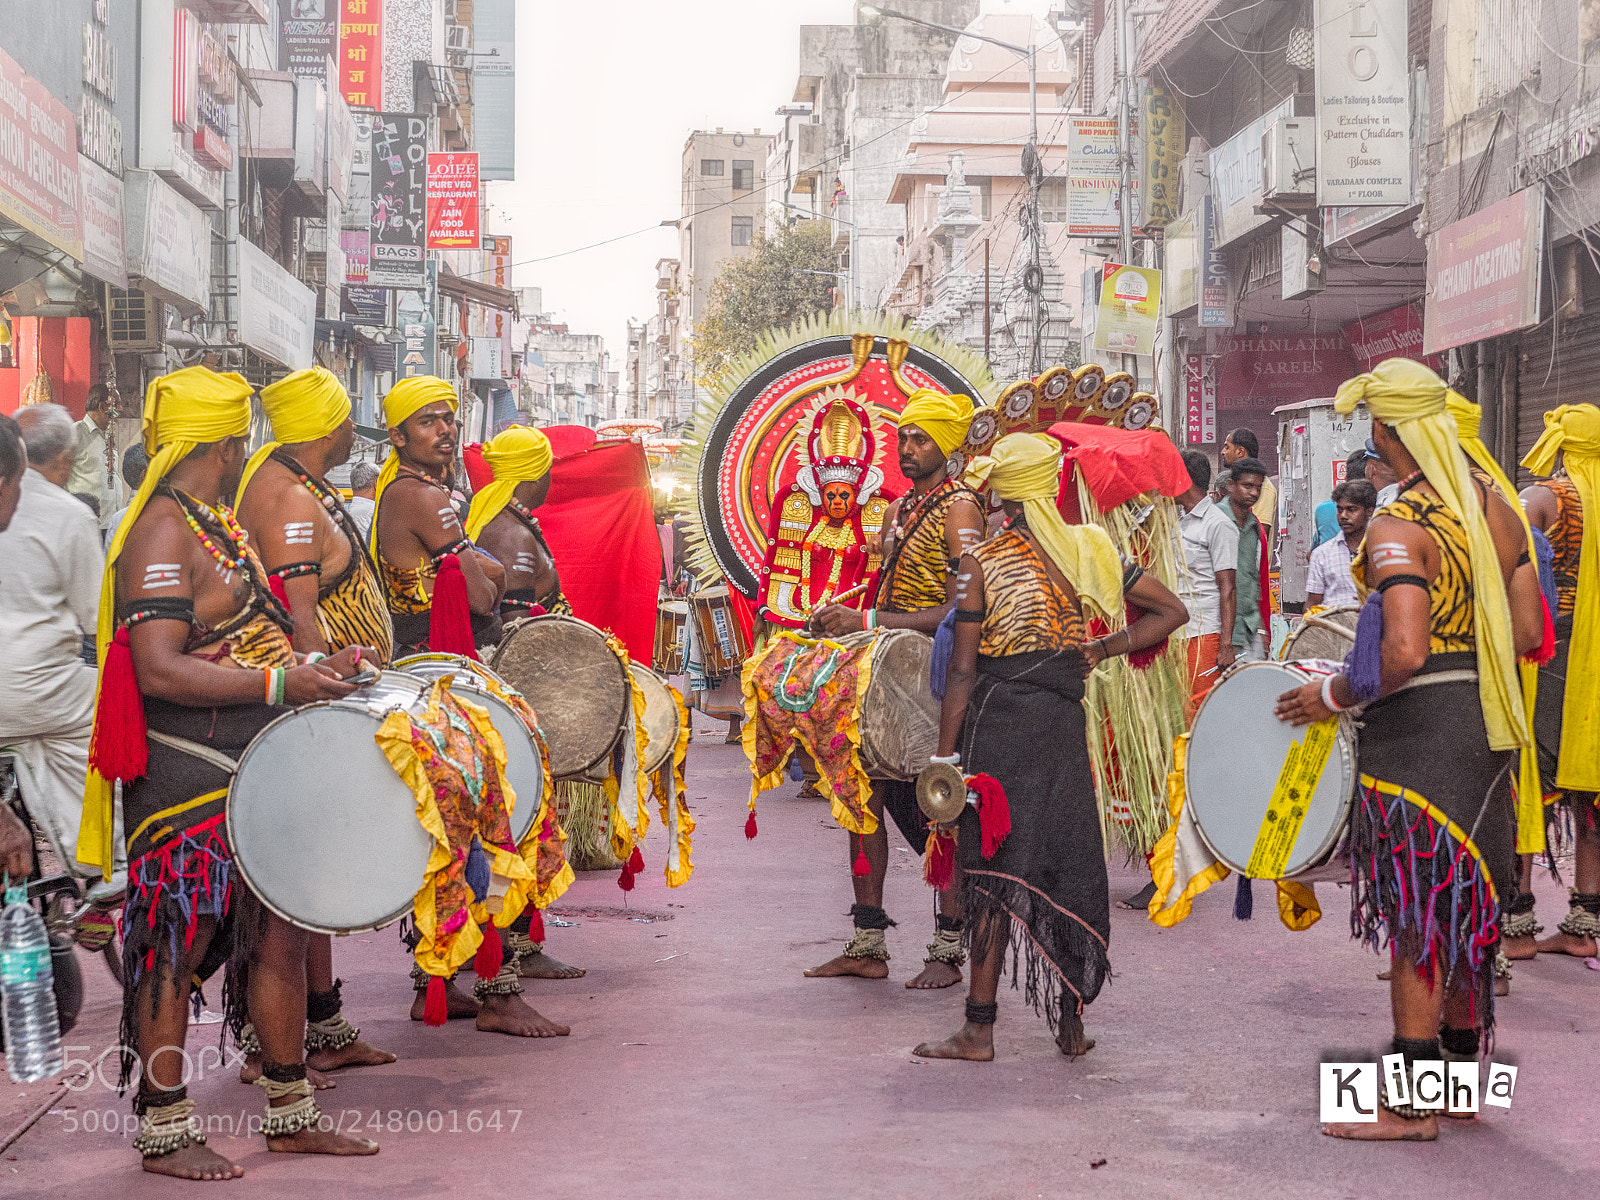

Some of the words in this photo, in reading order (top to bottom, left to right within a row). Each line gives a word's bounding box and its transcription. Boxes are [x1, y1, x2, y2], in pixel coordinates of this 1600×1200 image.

[283, 20, 335, 35] NISHA
[290, 55, 326, 63] BRIDAL
[1323, 96, 1343, 105] Ladies
[1344, 96, 1369, 106] Tailoring
[1370, 96, 1376, 104] &
[1377, 95, 1404, 107] Boutique
[1337, 115, 1380, 126] Exclusive
[1382, 115, 1390, 124] in
[1324, 129, 1358, 143] Pattern
[1360, 128, 1404, 141] Chudidars
[1360, 142, 1368, 153] &
[1347, 156, 1382, 168] Blouses
[27, 137, 78, 211] JEWELLERY
[405, 118, 426, 243] DOLLY
[1070, 180, 1105, 189] VARSHA
[1326, 178, 1365, 186] VARADAAN
[1366, 178, 1402, 186] COMPLEX
[441, 209, 462, 217] JAIN
[376, 247, 418, 257] BAGS
[1437, 258, 1472, 303] MEHANDI
[1473, 238, 1521, 290] CREATIONS
[1228, 337, 1345, 352] DHANLAXMI
[1394, 327, 1425, 349] Sarees
[403, 325, 426, 376] REAL
[1253, 361, 1323, 375] SAREES
[1189, 356, 1200, 442] DHANLAXMI
[1332, 422, 1353, 432] 14-7
